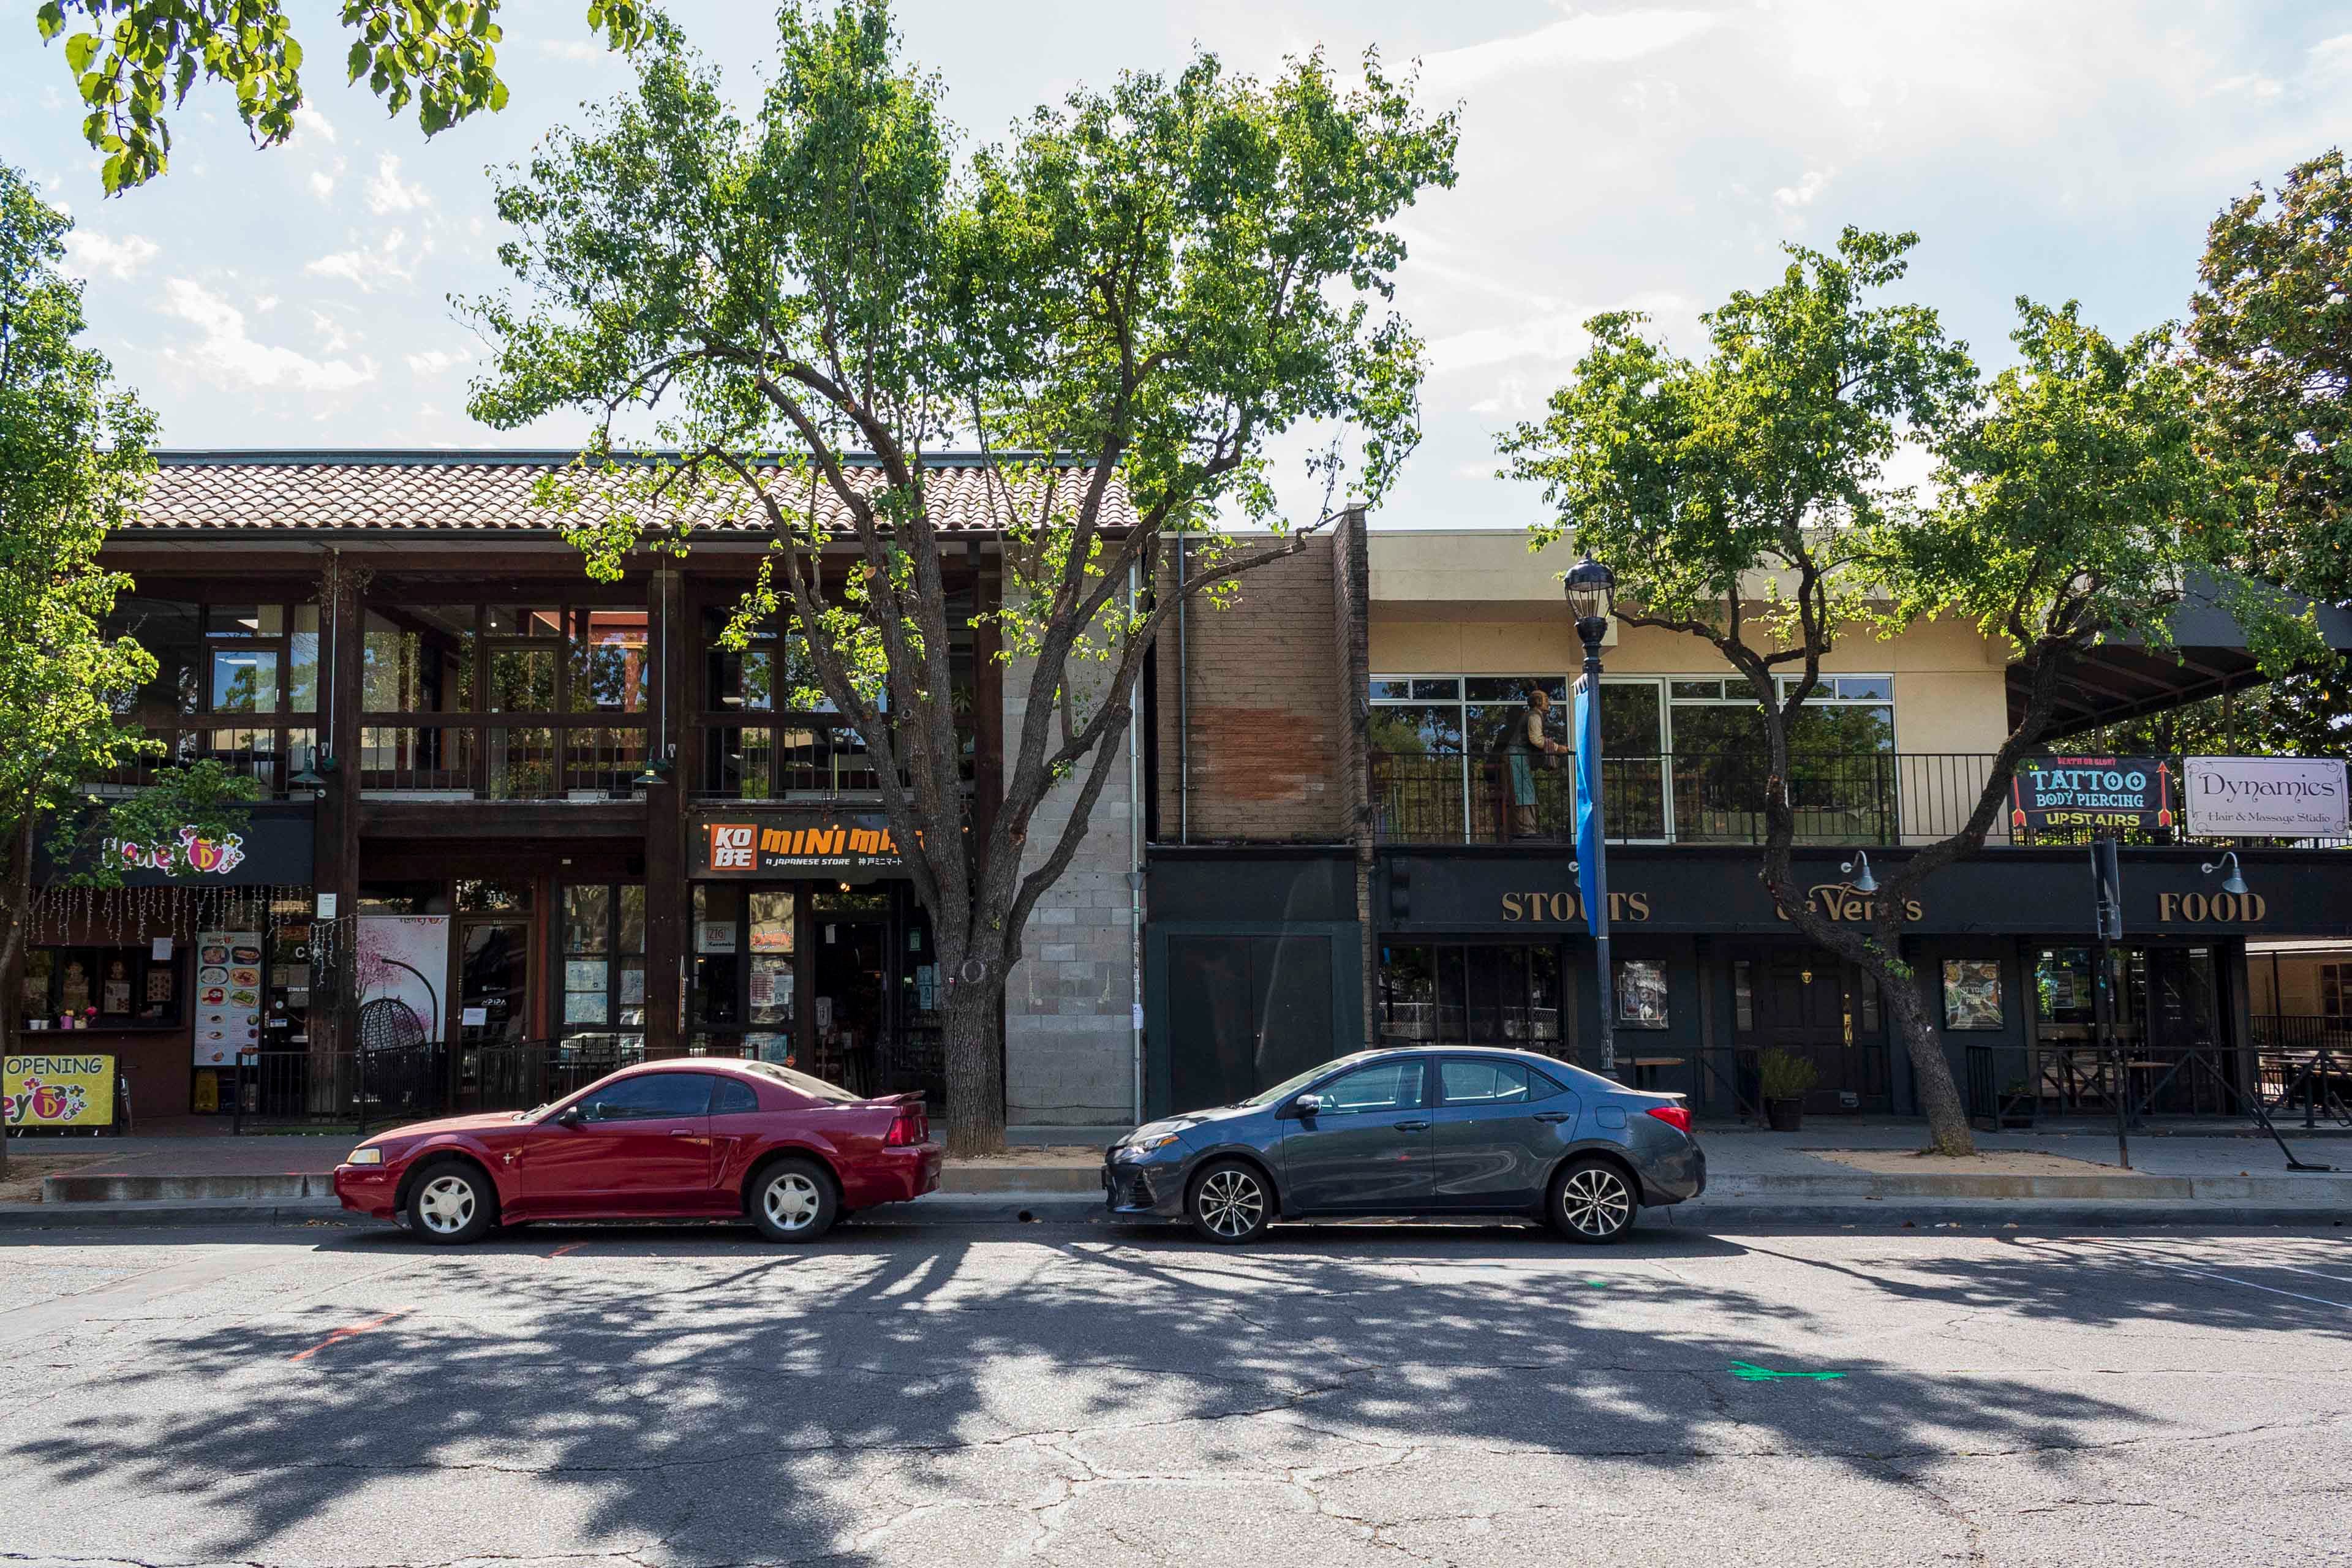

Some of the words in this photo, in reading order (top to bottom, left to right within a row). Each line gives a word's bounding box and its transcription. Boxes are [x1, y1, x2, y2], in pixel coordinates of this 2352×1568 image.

[2030, 770, 2146, 791] TATTOO
[2199, 772, 2335, 803] Dynamics
[2035, 790, 2074, 807] BODY
[2077, 794, 2144, 807] PIERCING
[2046, 813, 2140, 826] UPSTAIRS
[2208, 812, 2234, 822] Hair
[2248, 813, 2295, 824] Massage
[2297, 813, 2330, 822] Studio
[715, 827, 752, 848] KO
[715, 848, 752, 867] BE
[1809, 882, 1923, 921] Vers
[2160, 892, 2266, 922] FOOD
[7, 1058, 103, 1074] OPENING
